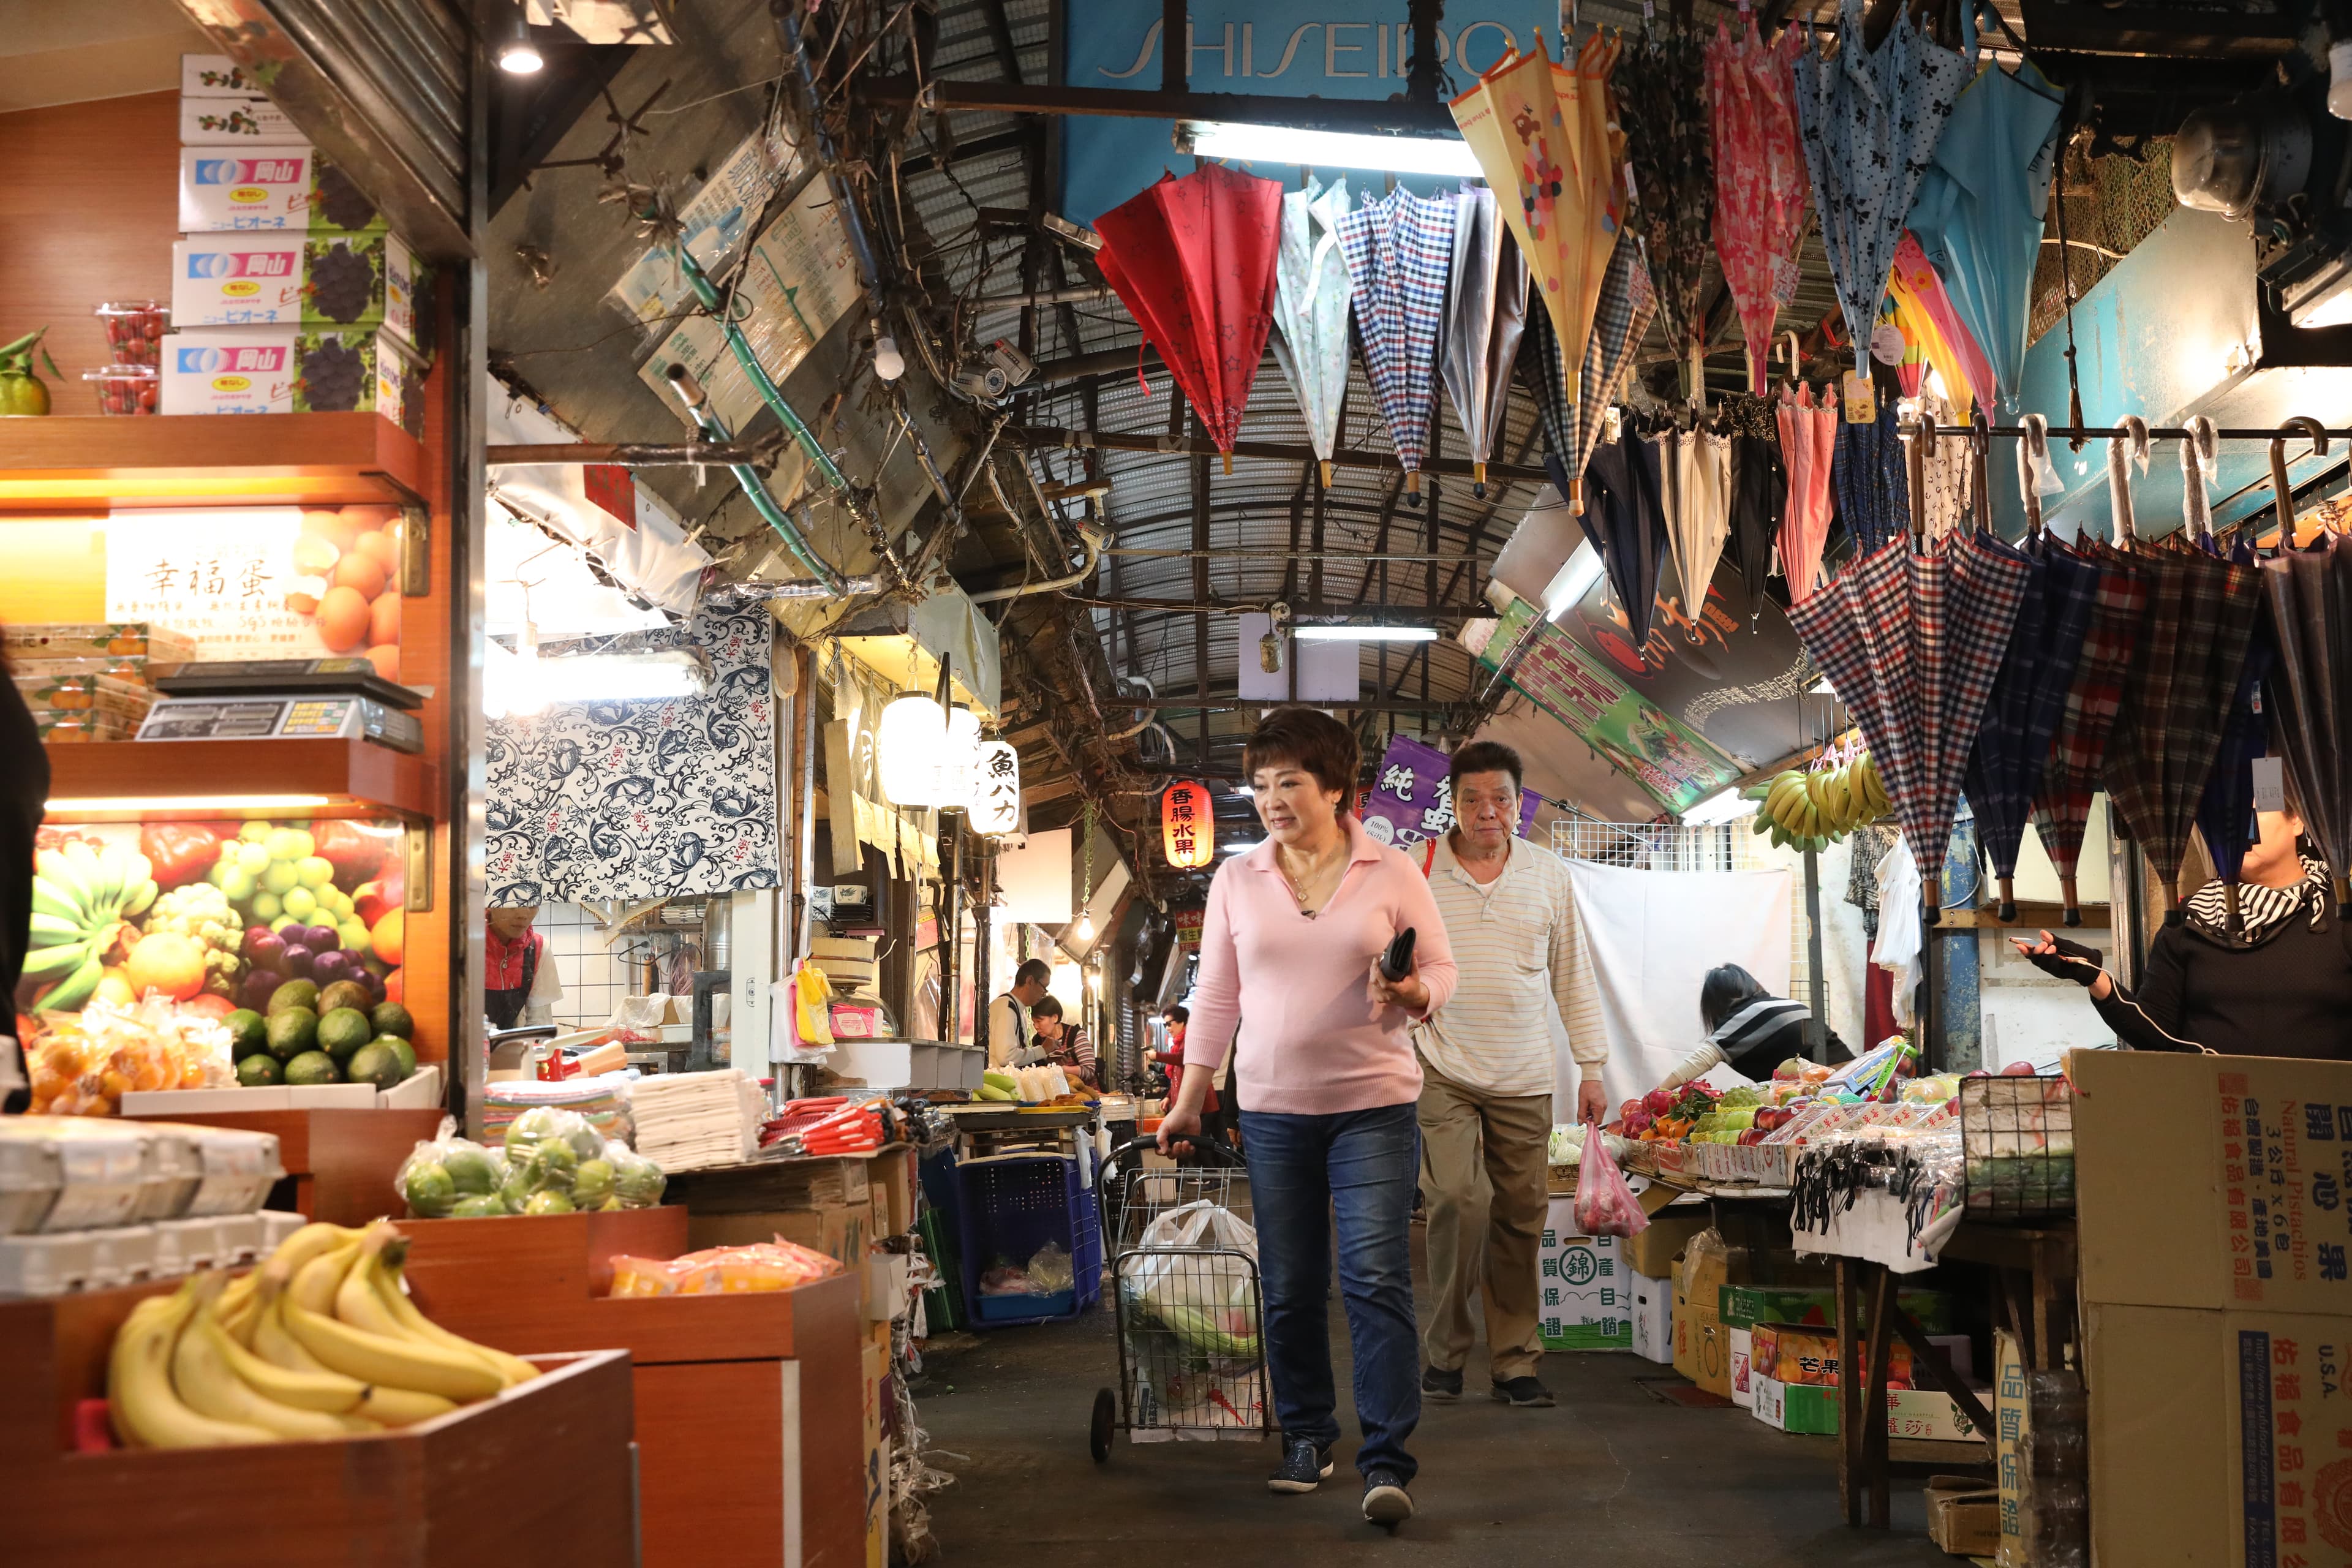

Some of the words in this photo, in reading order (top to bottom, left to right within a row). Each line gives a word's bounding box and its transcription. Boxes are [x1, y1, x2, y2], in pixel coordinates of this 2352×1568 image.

[254, 160, 295, 183] 岡山
[245, 254, 287, 276] 岡山
[235, 349, 277, 371] 岡山
[144, 559, 274, 598] 幸福蛋
[986, 750, 1016, 822] 魚バカ
[1380, 763, 1414, 801] 純
[1170, 788, 1196, 854] 香腸水果
[1370, 820, 1389, 834] 100%
[1874, 1061, 1893, 1090] ROCKIT
[2281, 1099, 2302, 1174] Natural
[2221, 1096, 2252, 1276] 佑福食品有限公司
[2304, 1102, 2348, 1281] 開心果
[2287, 1180, 2309, 1281] Pistachios
[1542, 1229, 1562, 1336] 品質保證
[1566, 1253, 1590, 1280] 錦
[1799, 1357, 1839, 1375] 芒果
[2318, 1344, 2338, 1399] U.S.A.
